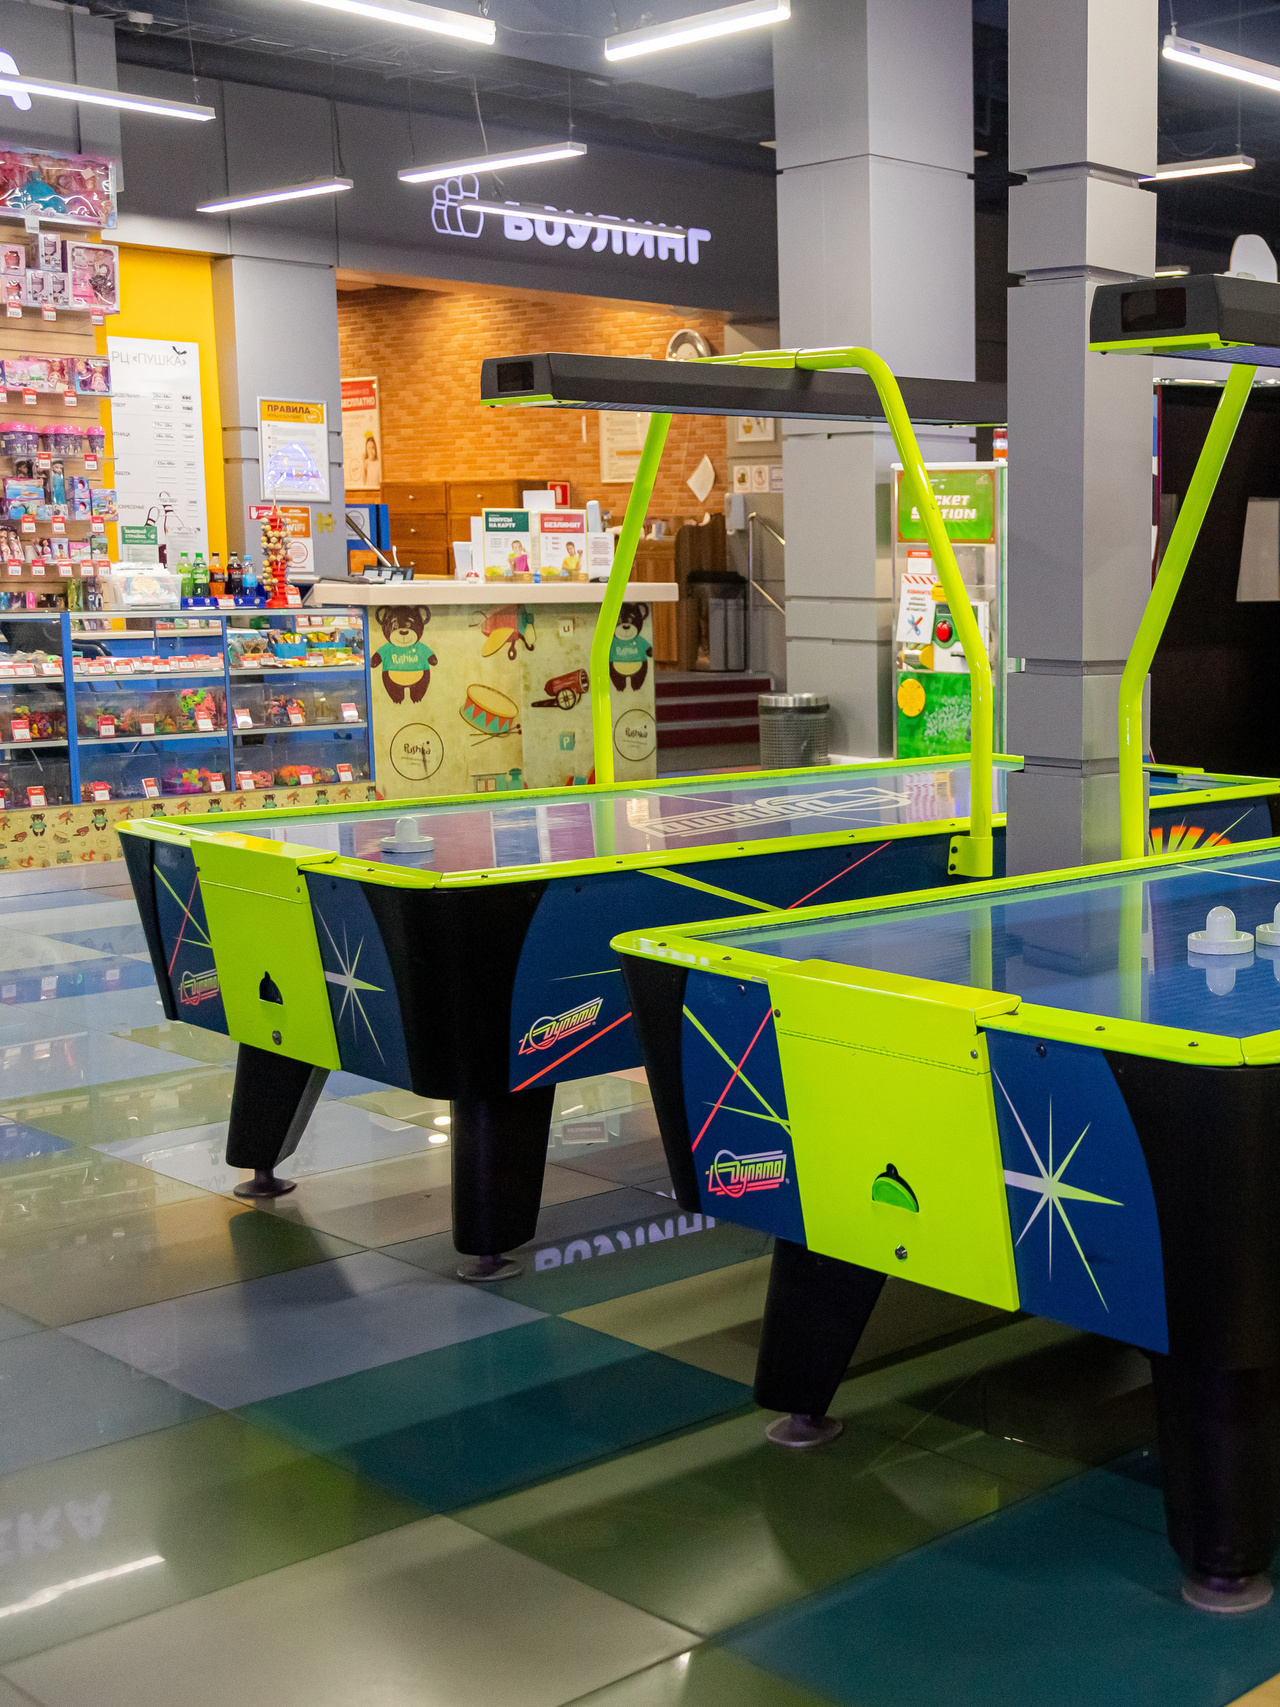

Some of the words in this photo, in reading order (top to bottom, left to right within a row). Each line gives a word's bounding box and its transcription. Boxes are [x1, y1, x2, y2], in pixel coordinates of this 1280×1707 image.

[267, 404, 311, 414] ПРАВИЛА
[934, 495, 970, 506] CKET
[911, 506, 977, 520] STION
[391, 650, 420, 664] Pushka
[404, 741, 432, 756] Pushka
